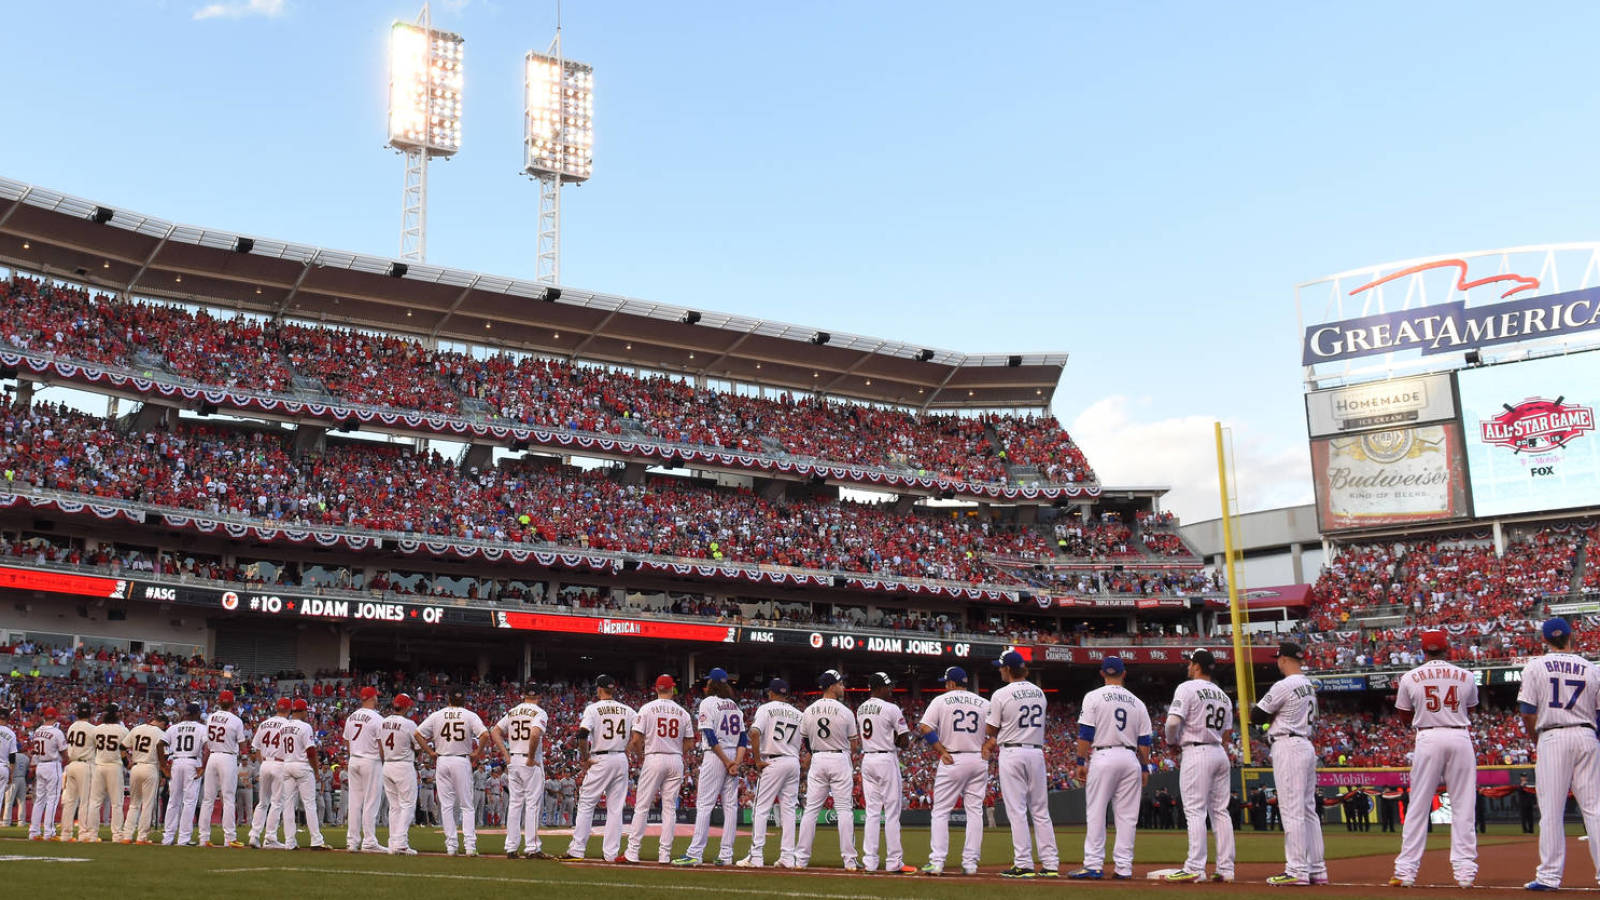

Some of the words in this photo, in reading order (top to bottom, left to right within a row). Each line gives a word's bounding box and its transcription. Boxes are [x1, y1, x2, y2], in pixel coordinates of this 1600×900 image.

[1310, 315, 1440, 357] GREAT
[1336, 391, 1420, 411] HOMEMADE
[1550, 411, 1589, 431] GAME
[1328, 467, 1448, 490] Budweiser
[1530, 466, 1554, 477] FOX
[145, 586, 176, 600] #ASG
[250, 595, 282, 613] #10
[300, 599, 348, 618] ADAM
[353, 602, 405, 621] JONES
[422, 607, 444, 624] OF
[750, 631, 774, 643] #ASG
[831, 635, 854, 650] #10
[867, 637, 902, 653] ADAM
[905, 639, 942, 656] JONES
[955, 643, 971, 657] OF
[1411, 668, 1468, 683] CHAPMAN
[1545, 660, 1587, 676] BRYANT
[945, 695, 984, 708] GONZALEZ
[1103, 692, 1136, 708] GRANDAL
[1423, 685, 1460, 713] 54
[1548, 677, 1586, 710] 17
[444, 711, 462, 720] COLE
[597, 706, 627, 716] BURNETT
[811, 706, 841, 716] BRAUN
[1019, 704, 1042, 729] 22
[1114, 708, 1127, 731] 9
[1205, 703, 1226, 731] 28
[511, 720, 531, 741] 35
[602, 719, 626, 740] 34
[657, 717, 679, 738] 58
[720, 714, 740, 736] 48
[817, 717, 831, 739] 8
[863, 718, 873, 740] 9
[952, 709, 979, 733] 23
[67, 731, 86, 747] 40
[208, 725, 226, 743] 52
[262, 730, 281, 749] 44
[352, 723, 363, 741] 7
[385, 732, 395, 750] 4
[440, 722, 465, 742] 45
[773, 721, 798, 744] 57
[31, 740, 46, 756] 31
[96, 734, 119, 752] 35
[134, 734, 152, 753] 12
[175, 734, 195, 752] 10
[283, 736, 294, 754] 18
